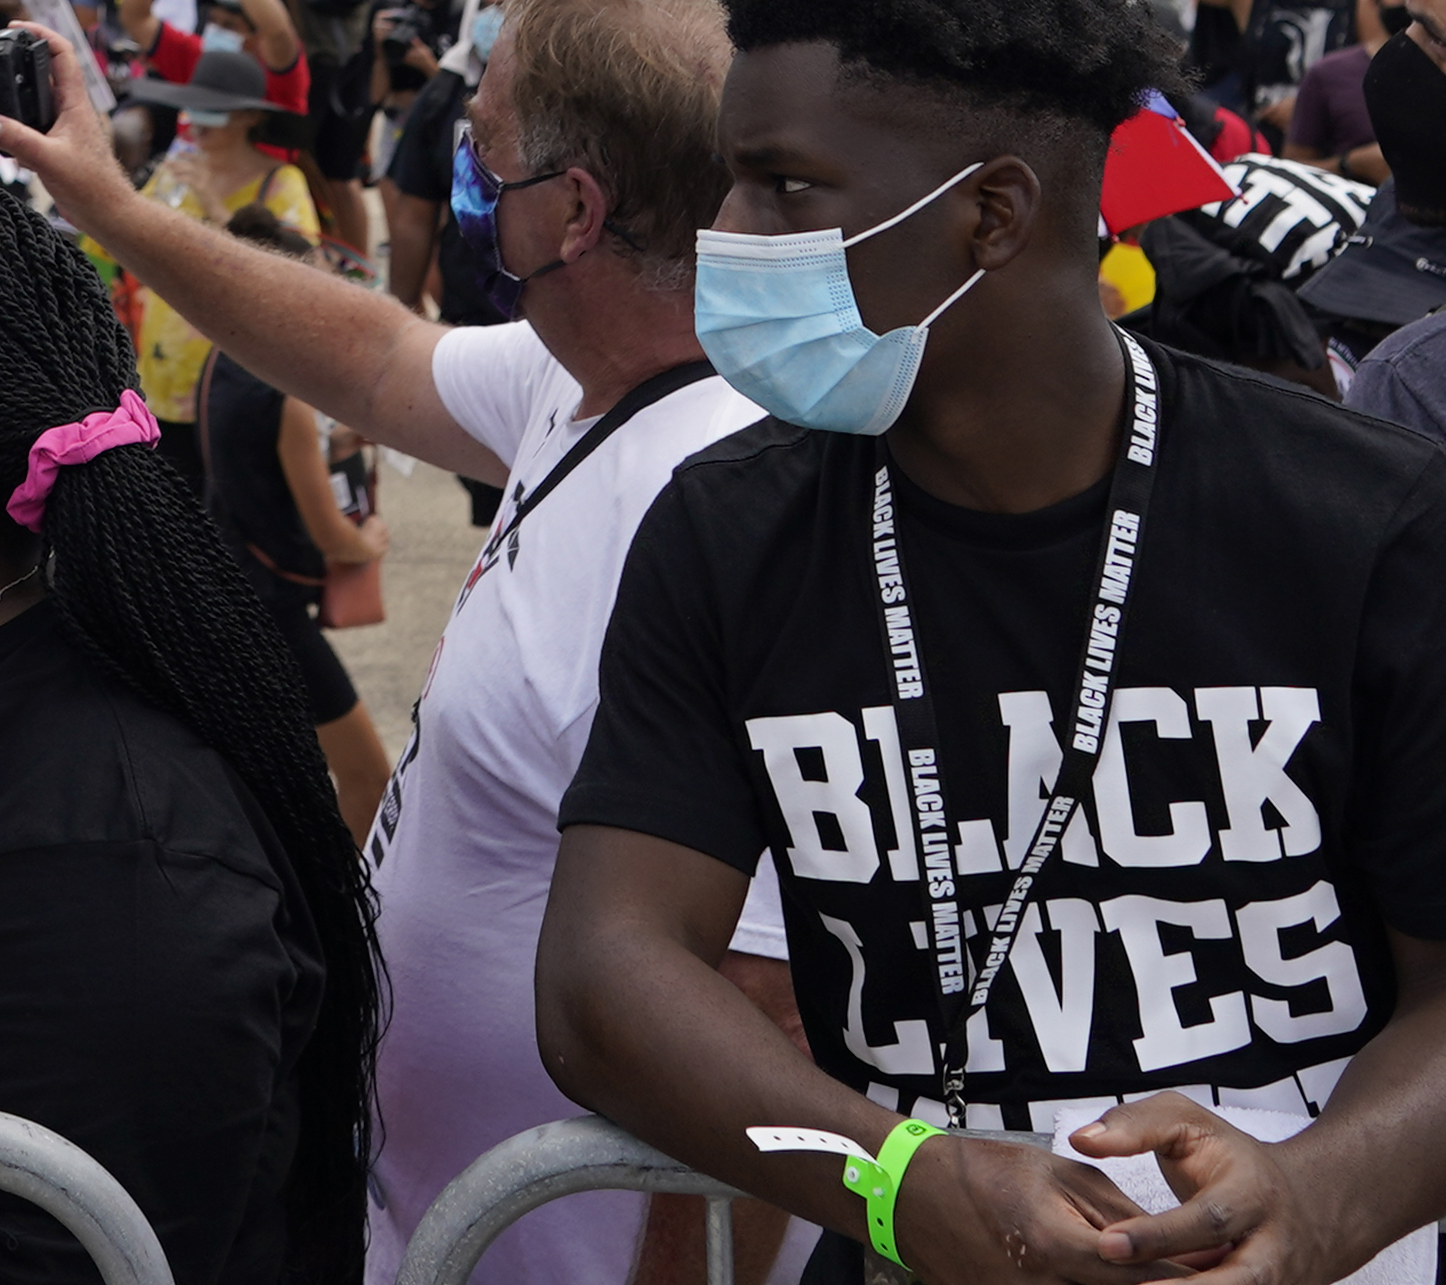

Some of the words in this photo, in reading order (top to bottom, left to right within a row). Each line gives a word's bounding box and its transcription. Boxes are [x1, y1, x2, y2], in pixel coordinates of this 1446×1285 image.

[1127, 387, 1157, 466] BLACK
[873, 466, 895, 538] BLACK
[873, 538, 907, 604] LIVES
[1097, 508, 1141, 598] MATTER
[884, 604, 924, 700] MATTER
[1085, 599, 1121, 674] LIVES
[1072, 673, 1108, 755] BLACK
[745, 685, 1322, 885] BLACK
[908, 747, 946, 829] BLACK
[921, 830, 956, 900] LIVES
[971, 933, 1011, 1006] BLACK
[995, 875, 1032, 942] LIVES
[1024, 795, 1074, 876] MATTER
[931, 901, 966, 995] MATTER
